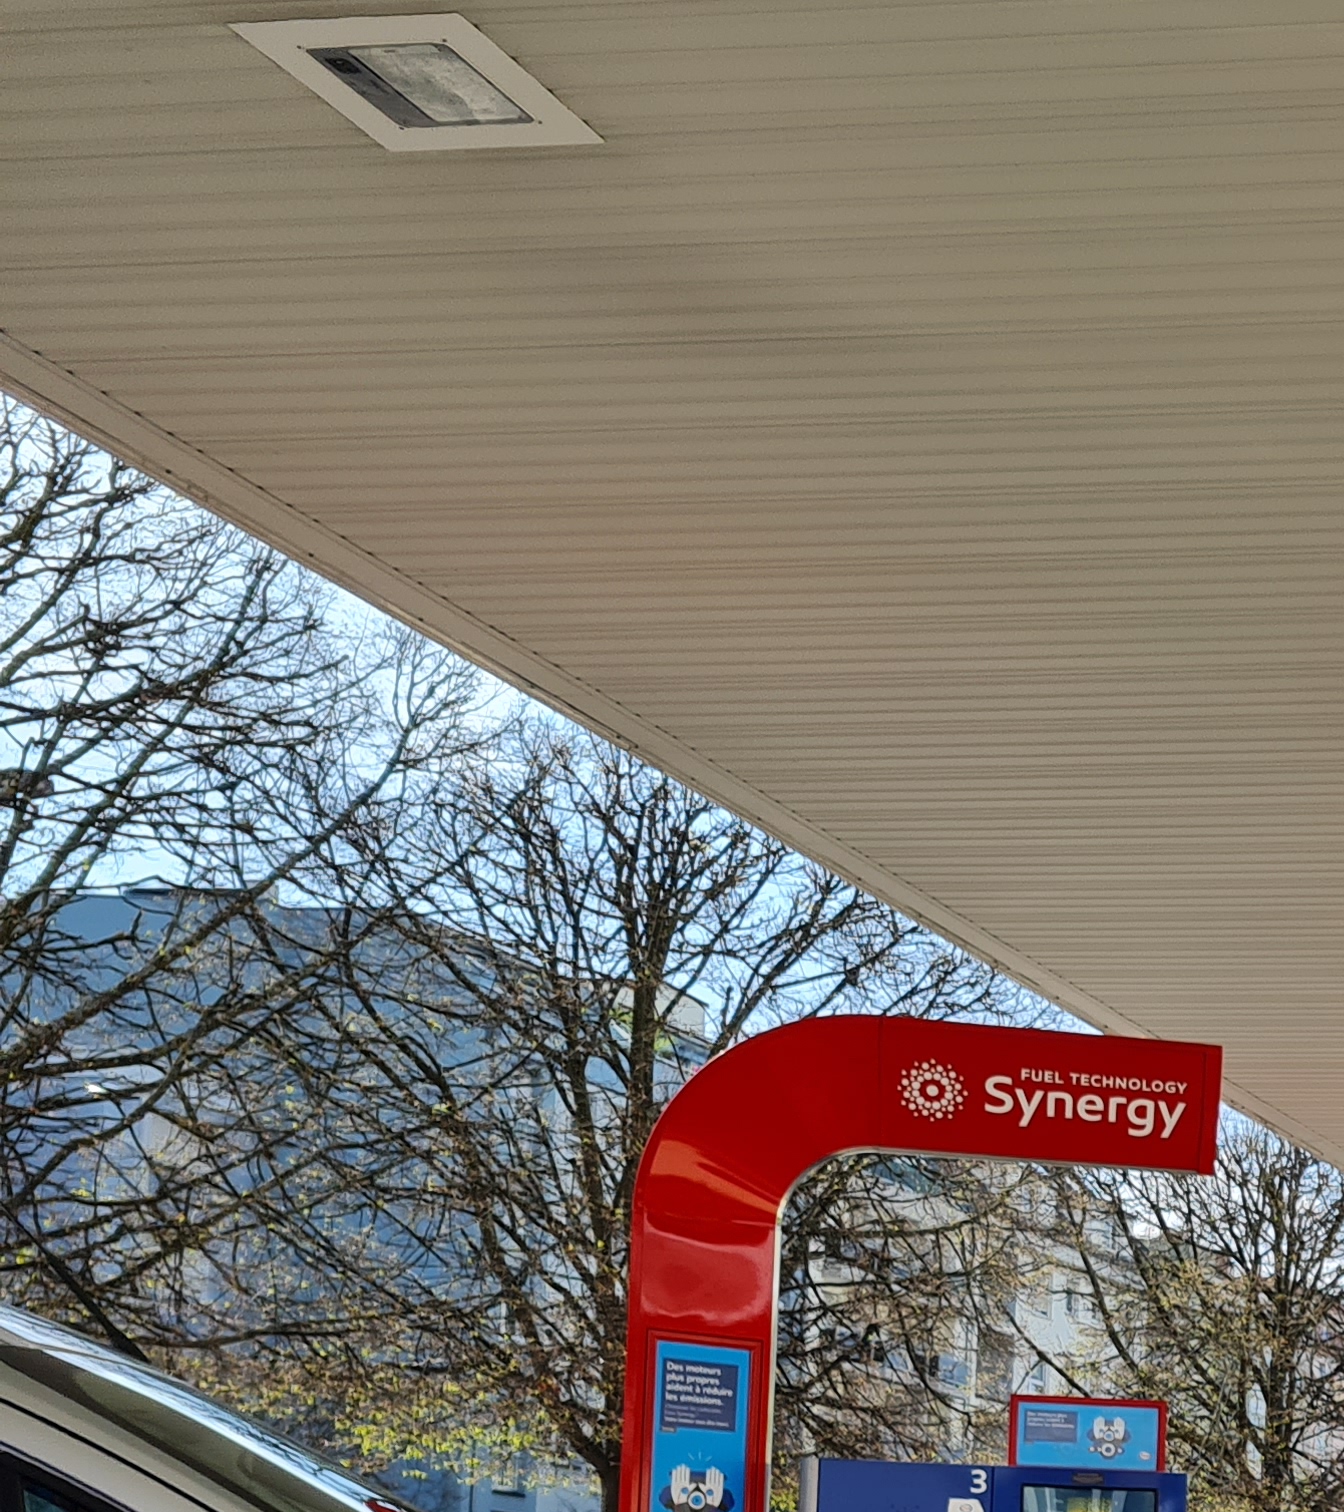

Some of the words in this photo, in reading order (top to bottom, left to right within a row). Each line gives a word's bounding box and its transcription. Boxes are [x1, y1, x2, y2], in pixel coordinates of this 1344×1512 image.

[1020, 1068, 1064, 1084] FUEL
[1069, 1072, 1187, 1094] TECHNOLOGY
[984, 1075, 1187, 1138] Synergy
[666, 1361, 683, 1371] Des
[686, 1364, 721, 1376] moteurs
[666, 1372, 684, 1382] plus
[686, 1375, 719, 1386] propres
[970, 1468, 987, 1494] 3
